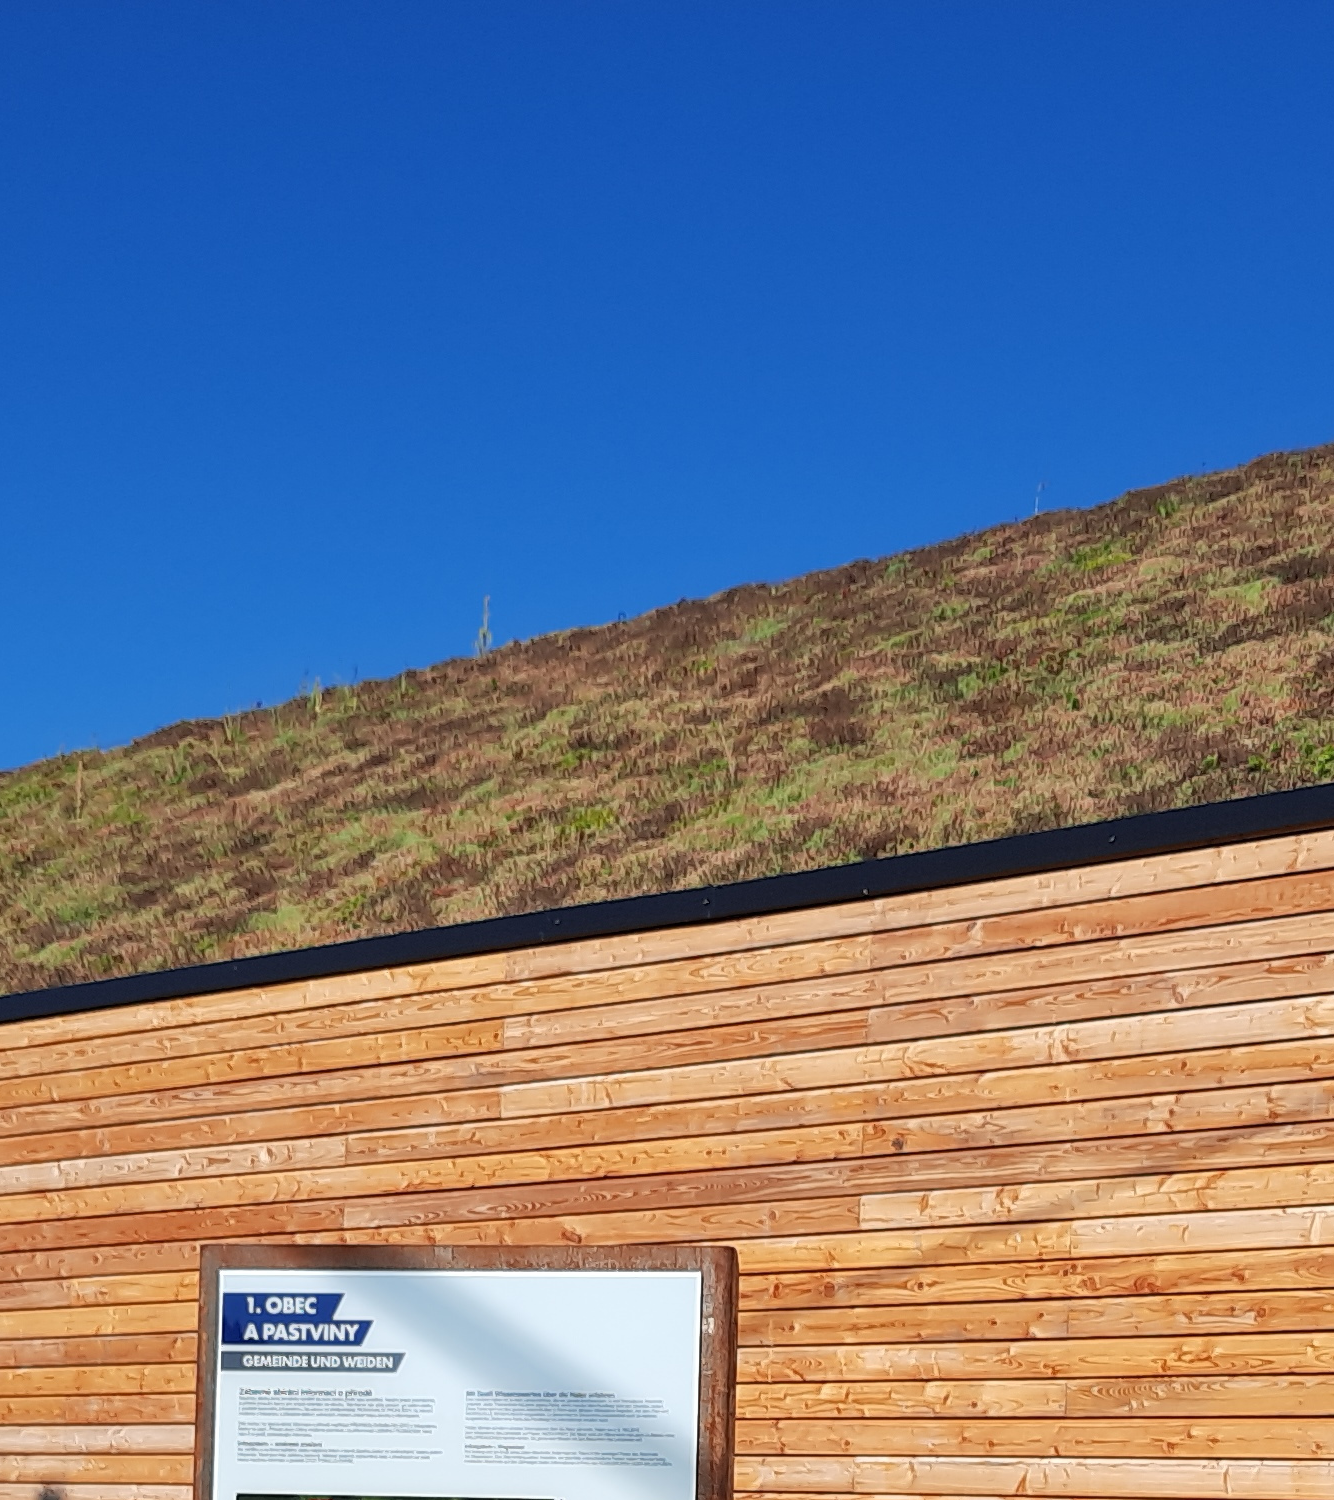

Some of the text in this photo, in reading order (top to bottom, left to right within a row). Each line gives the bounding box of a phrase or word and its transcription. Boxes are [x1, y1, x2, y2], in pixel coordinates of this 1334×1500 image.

[246, 1296, 317, 1315] 1. OBEC
[243, 1323, 360, 1342] A PASTVINY
[242, 1354, 394, 1370] GEMEINDE UND WEIDEN
